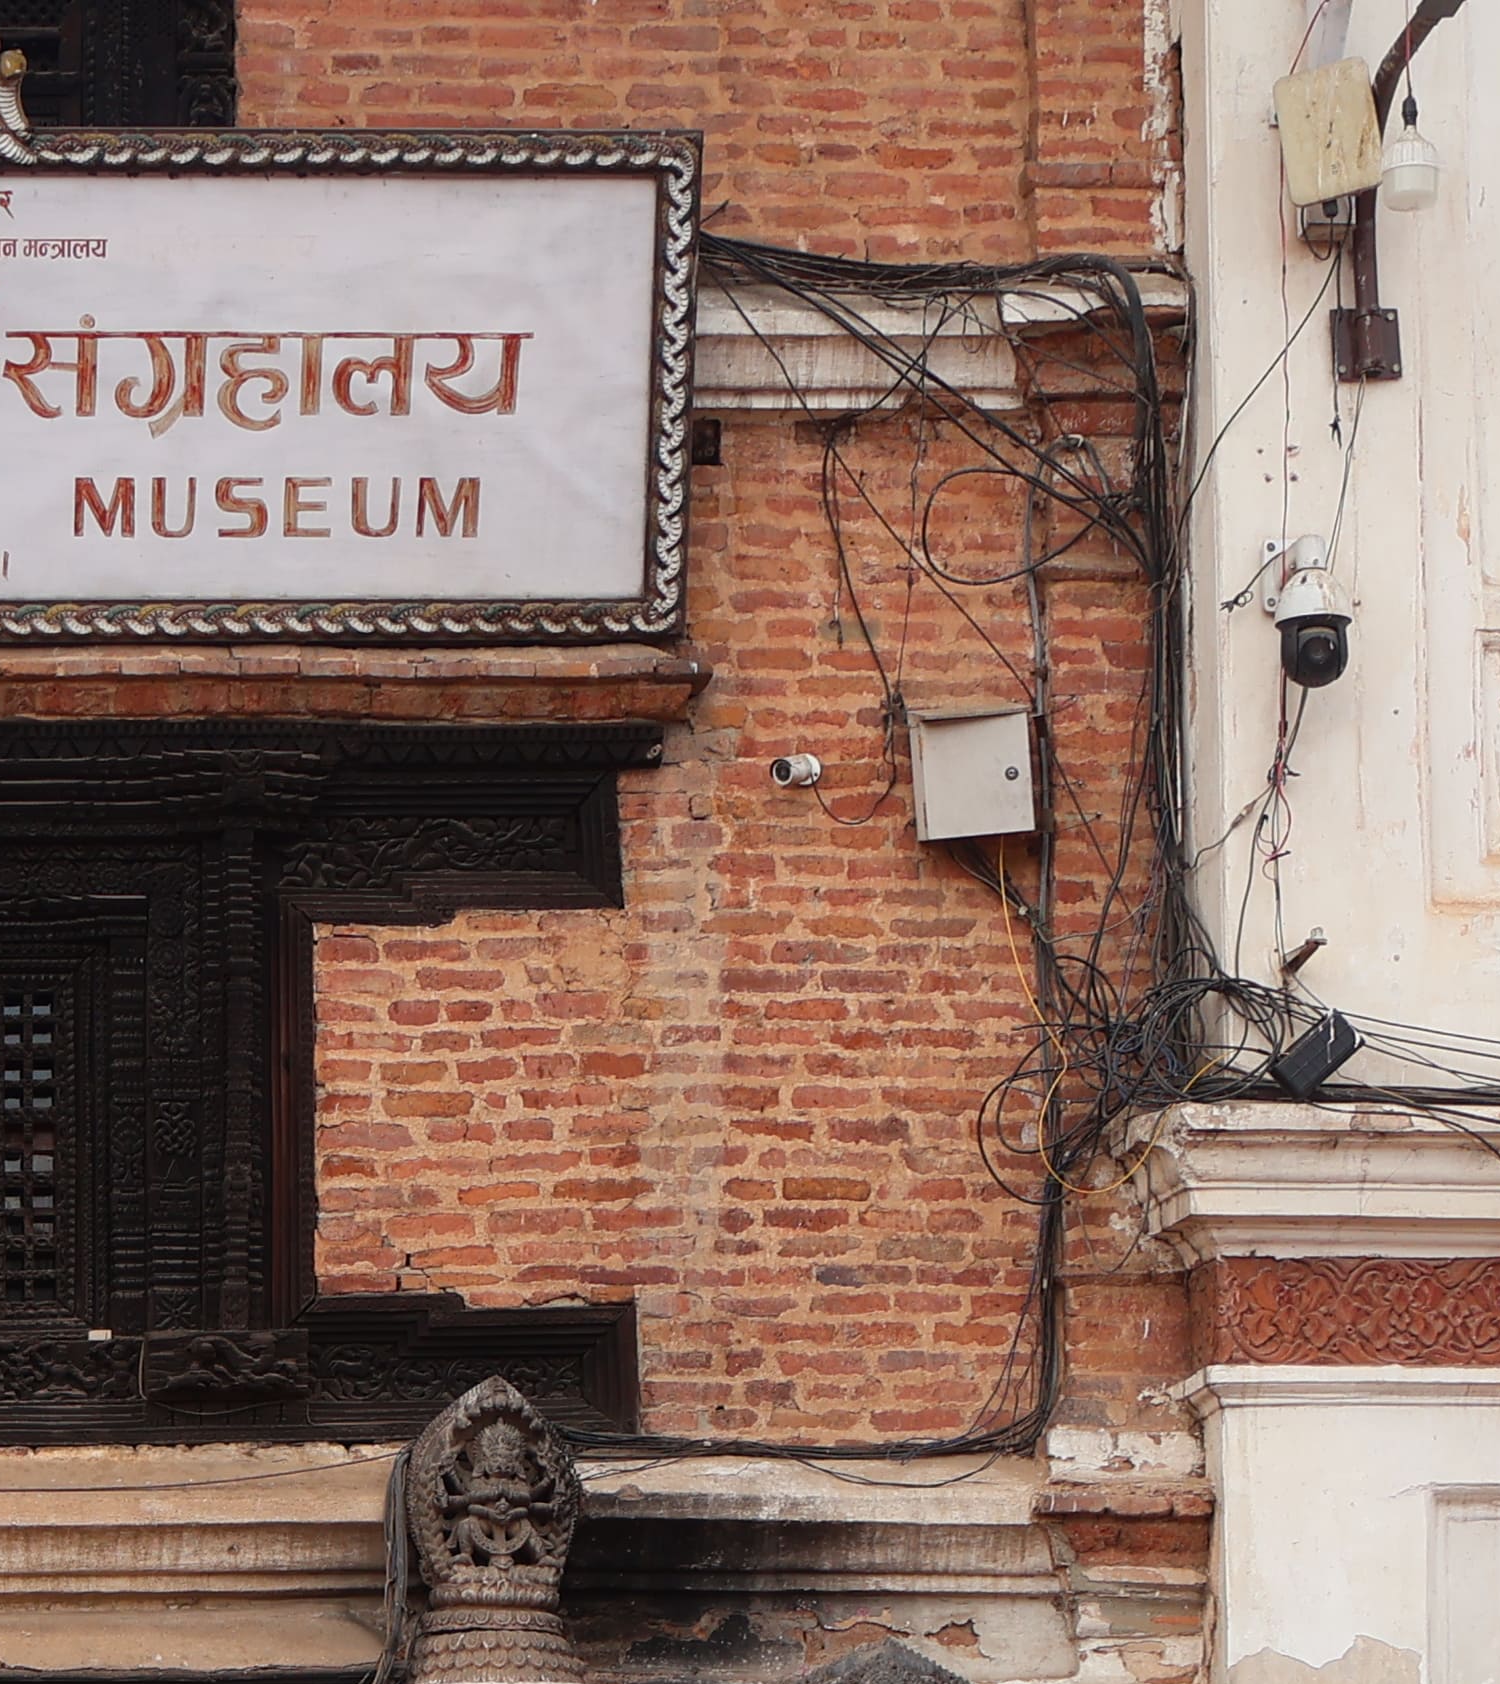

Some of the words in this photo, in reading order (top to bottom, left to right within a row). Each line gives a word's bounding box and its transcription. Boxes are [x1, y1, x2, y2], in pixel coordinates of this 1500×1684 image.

[23, 238, 109, 260] मन्त्रालय
[2, 314, 534, 438] संग्रहालय
[74, 477, 480, 538] MUSEUM
